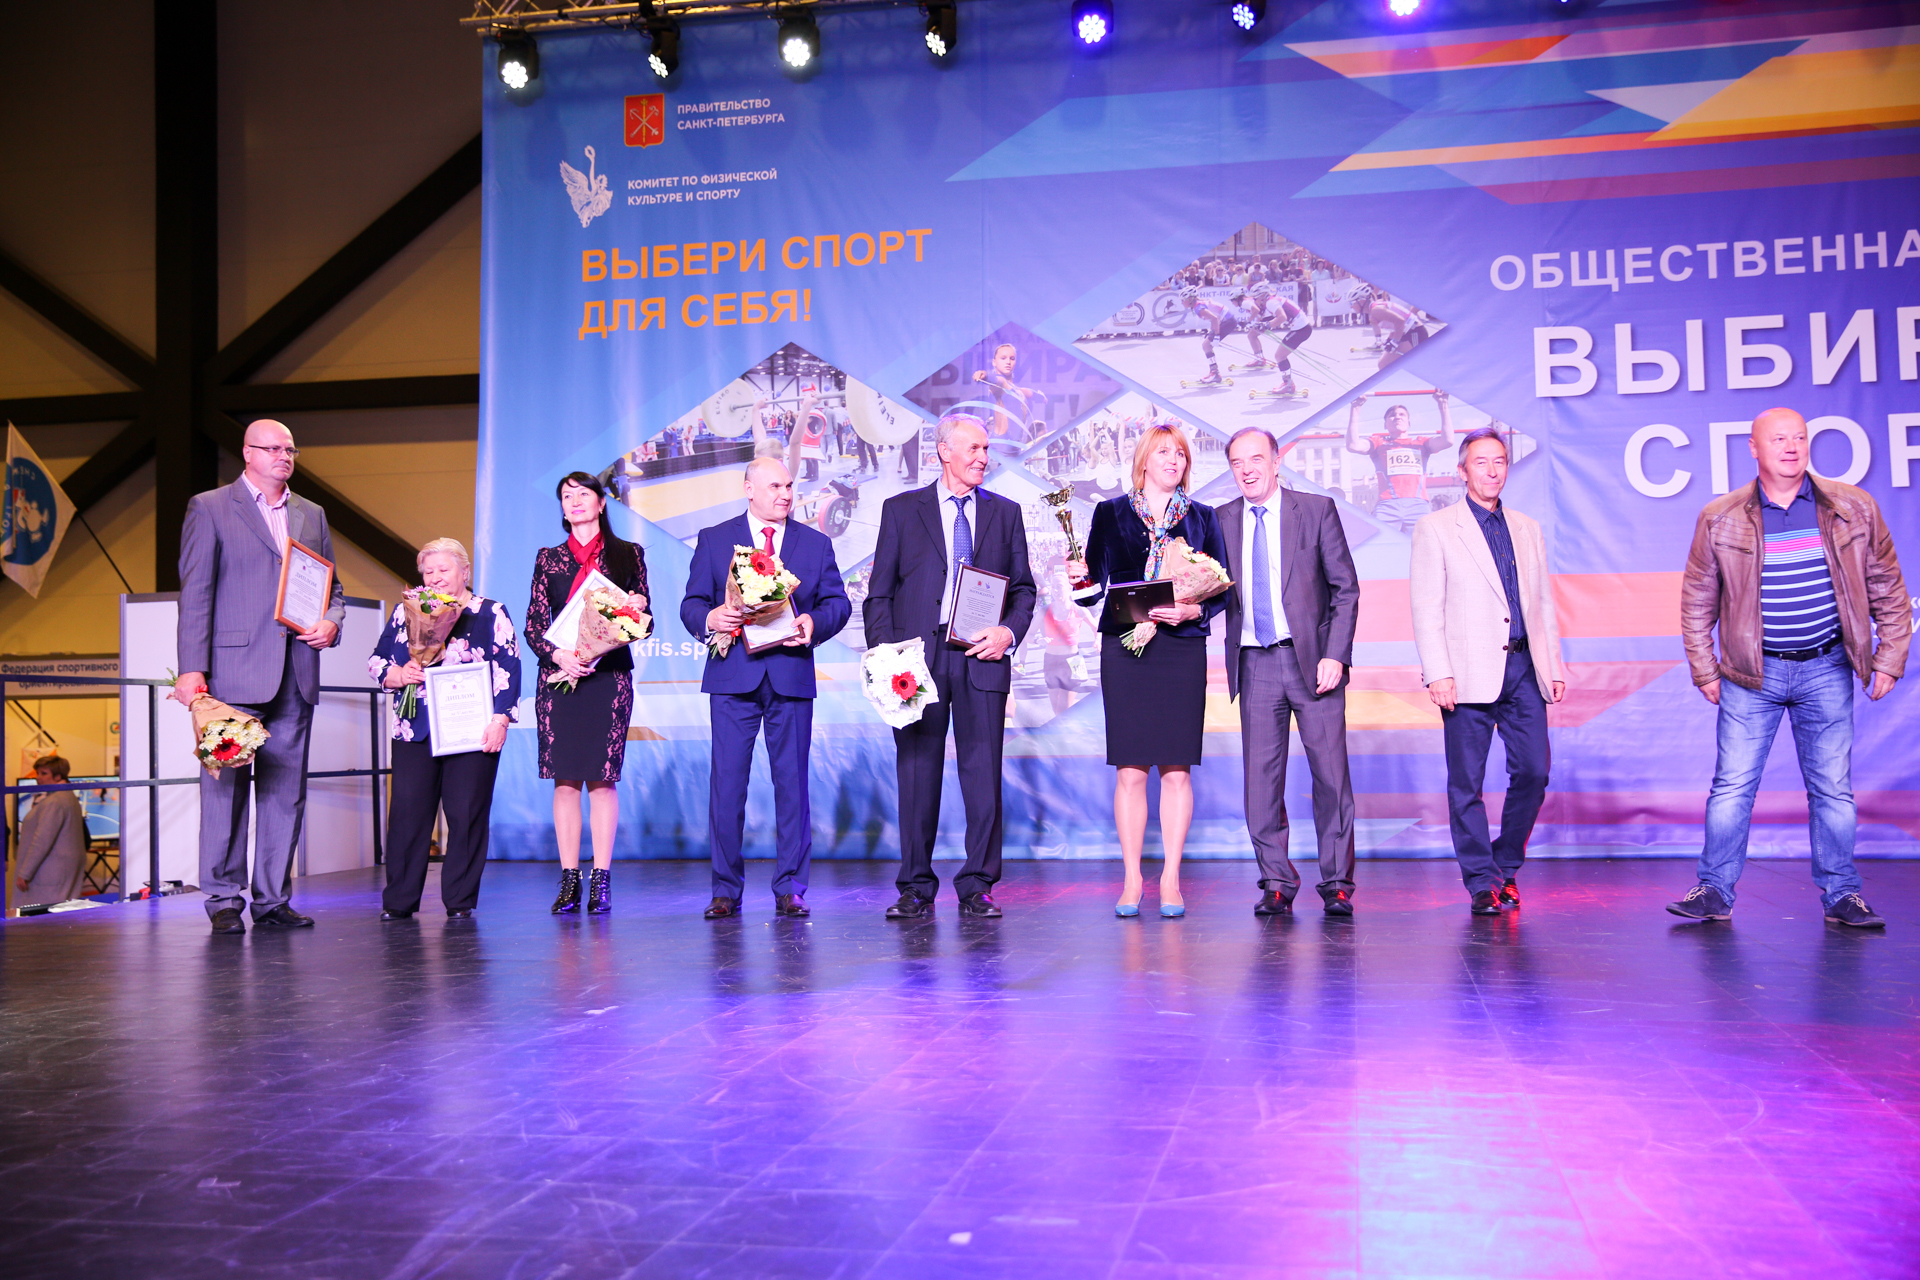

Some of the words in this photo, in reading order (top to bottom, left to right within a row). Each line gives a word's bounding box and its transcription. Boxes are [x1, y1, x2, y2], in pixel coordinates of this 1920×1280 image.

[677, 97, 771, 114] ПРАВИТЕЛЬСТВО
[677, 113, 785, 131] САНКТ-ПЕТЕРБУРГА
[627, 176, 679, 190] КОМИТЕТ
[681, 175, 698, 187] ПО
[700, 167, 778, 186] ФИЗИЧЕСКОЙ
[627, 190, 683, 206] КУЛЬТУРЕ
[685, 191, 694, 202] И
[696, 187, 741, 201] СПОРТУ
[581, 238, 767, 283] ВЫБЕРИ
[781, 228, 933, 270] СПОРТ
[1489, 229, 1920, 293] ОБЩЕСТВЕННА
[578, 296, 666, 341] ДЛЯ
[681, 288, 812, 329] СЕБЯ!
[1, 663, 55, 675] Федерация
[57, 663, 119, 674] спортивного
[445, 692, 475, 702] ДИПЛОМ
